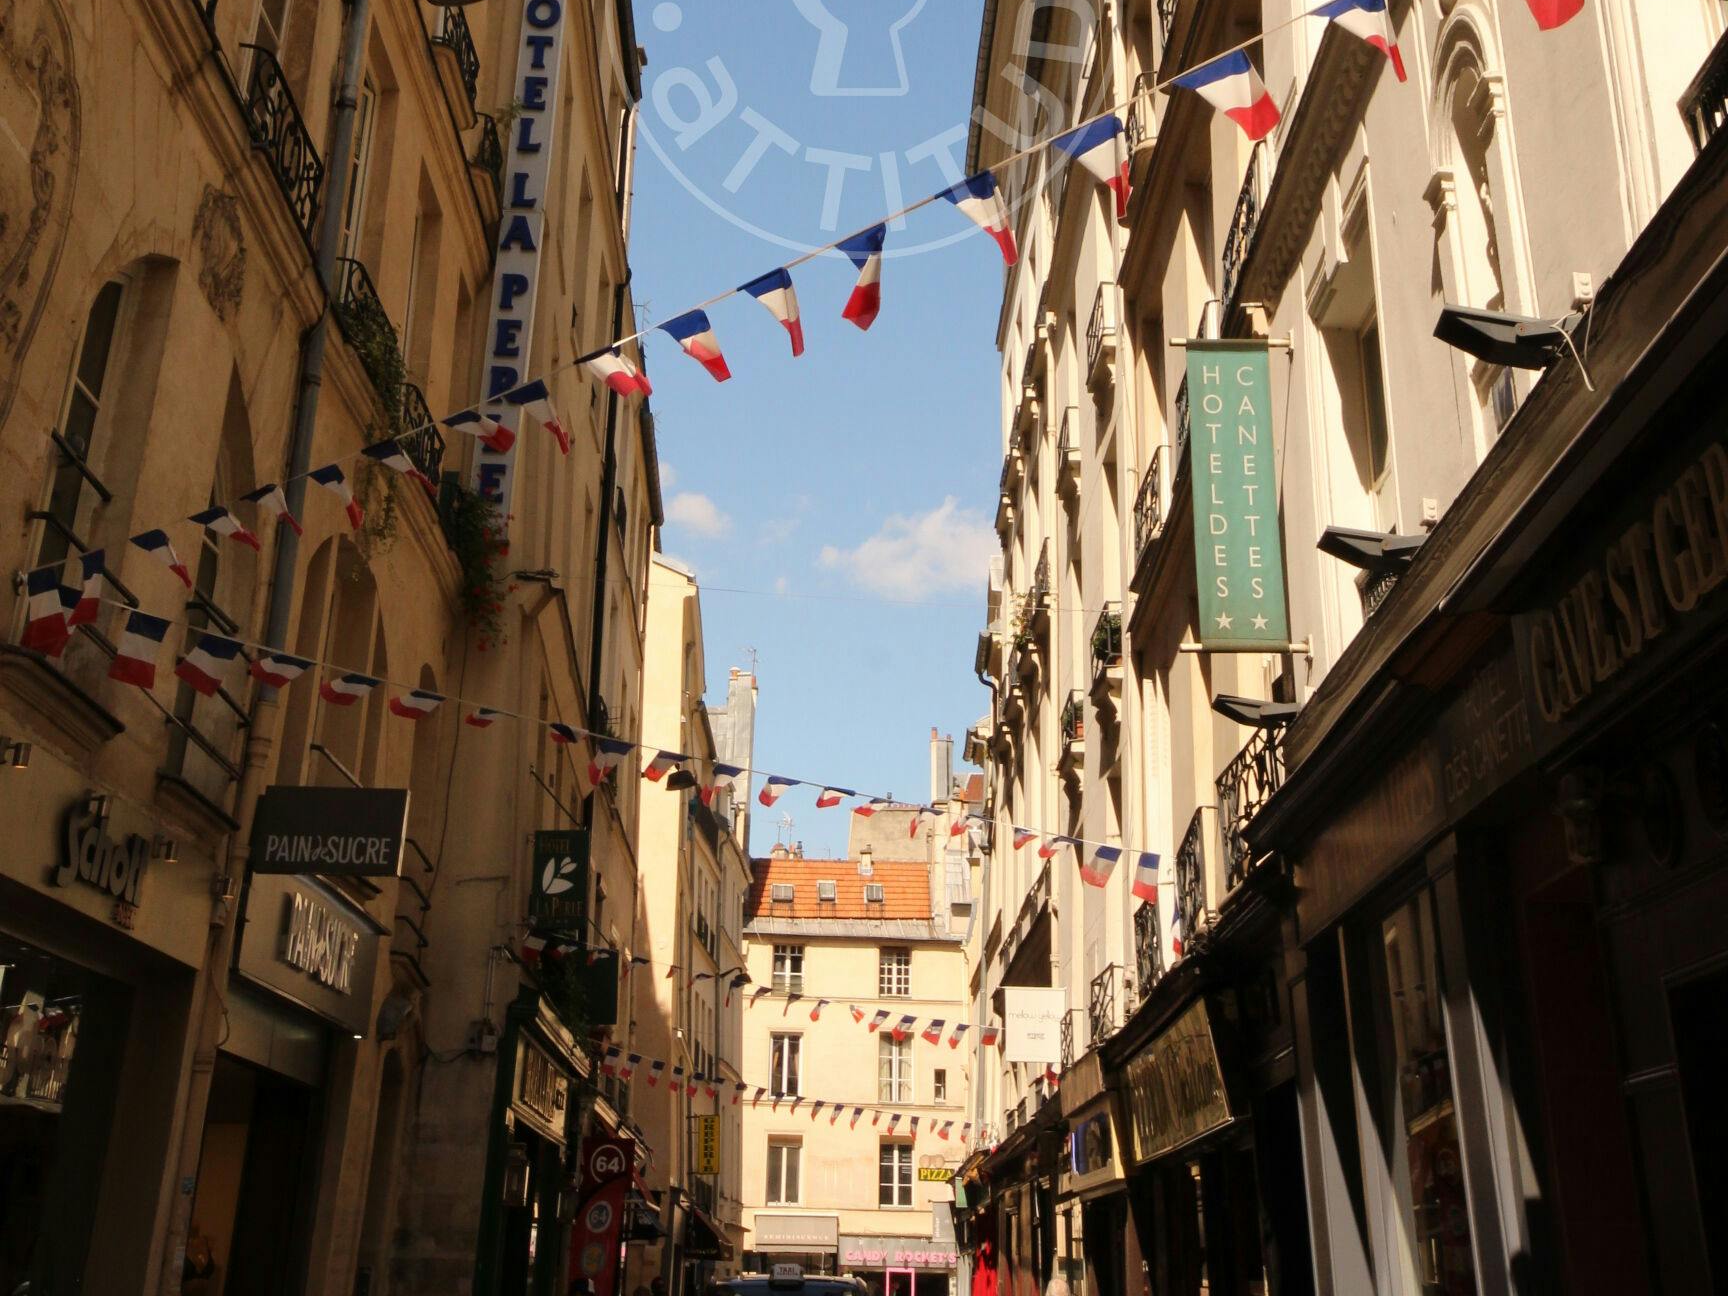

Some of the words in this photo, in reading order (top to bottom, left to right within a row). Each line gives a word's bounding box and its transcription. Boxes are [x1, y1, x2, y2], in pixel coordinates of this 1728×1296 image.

[500, 172, 538, 253] LA
[1203, 365, 1226, 506] HOTEL
[1236, 366, 1265, 599] CANETTES
[1210, 514, 1228, 599] DES
[56, 808, 143, 907] Scholl
[265, 835, 312, 862] PAIN
[326, 835, 392, 864] SUCRE
[596, 1155, 620, 1174] 64
[920, 1168, 953, 1181] PIZZA
[846, 1250, 888, 1262] CANDY
